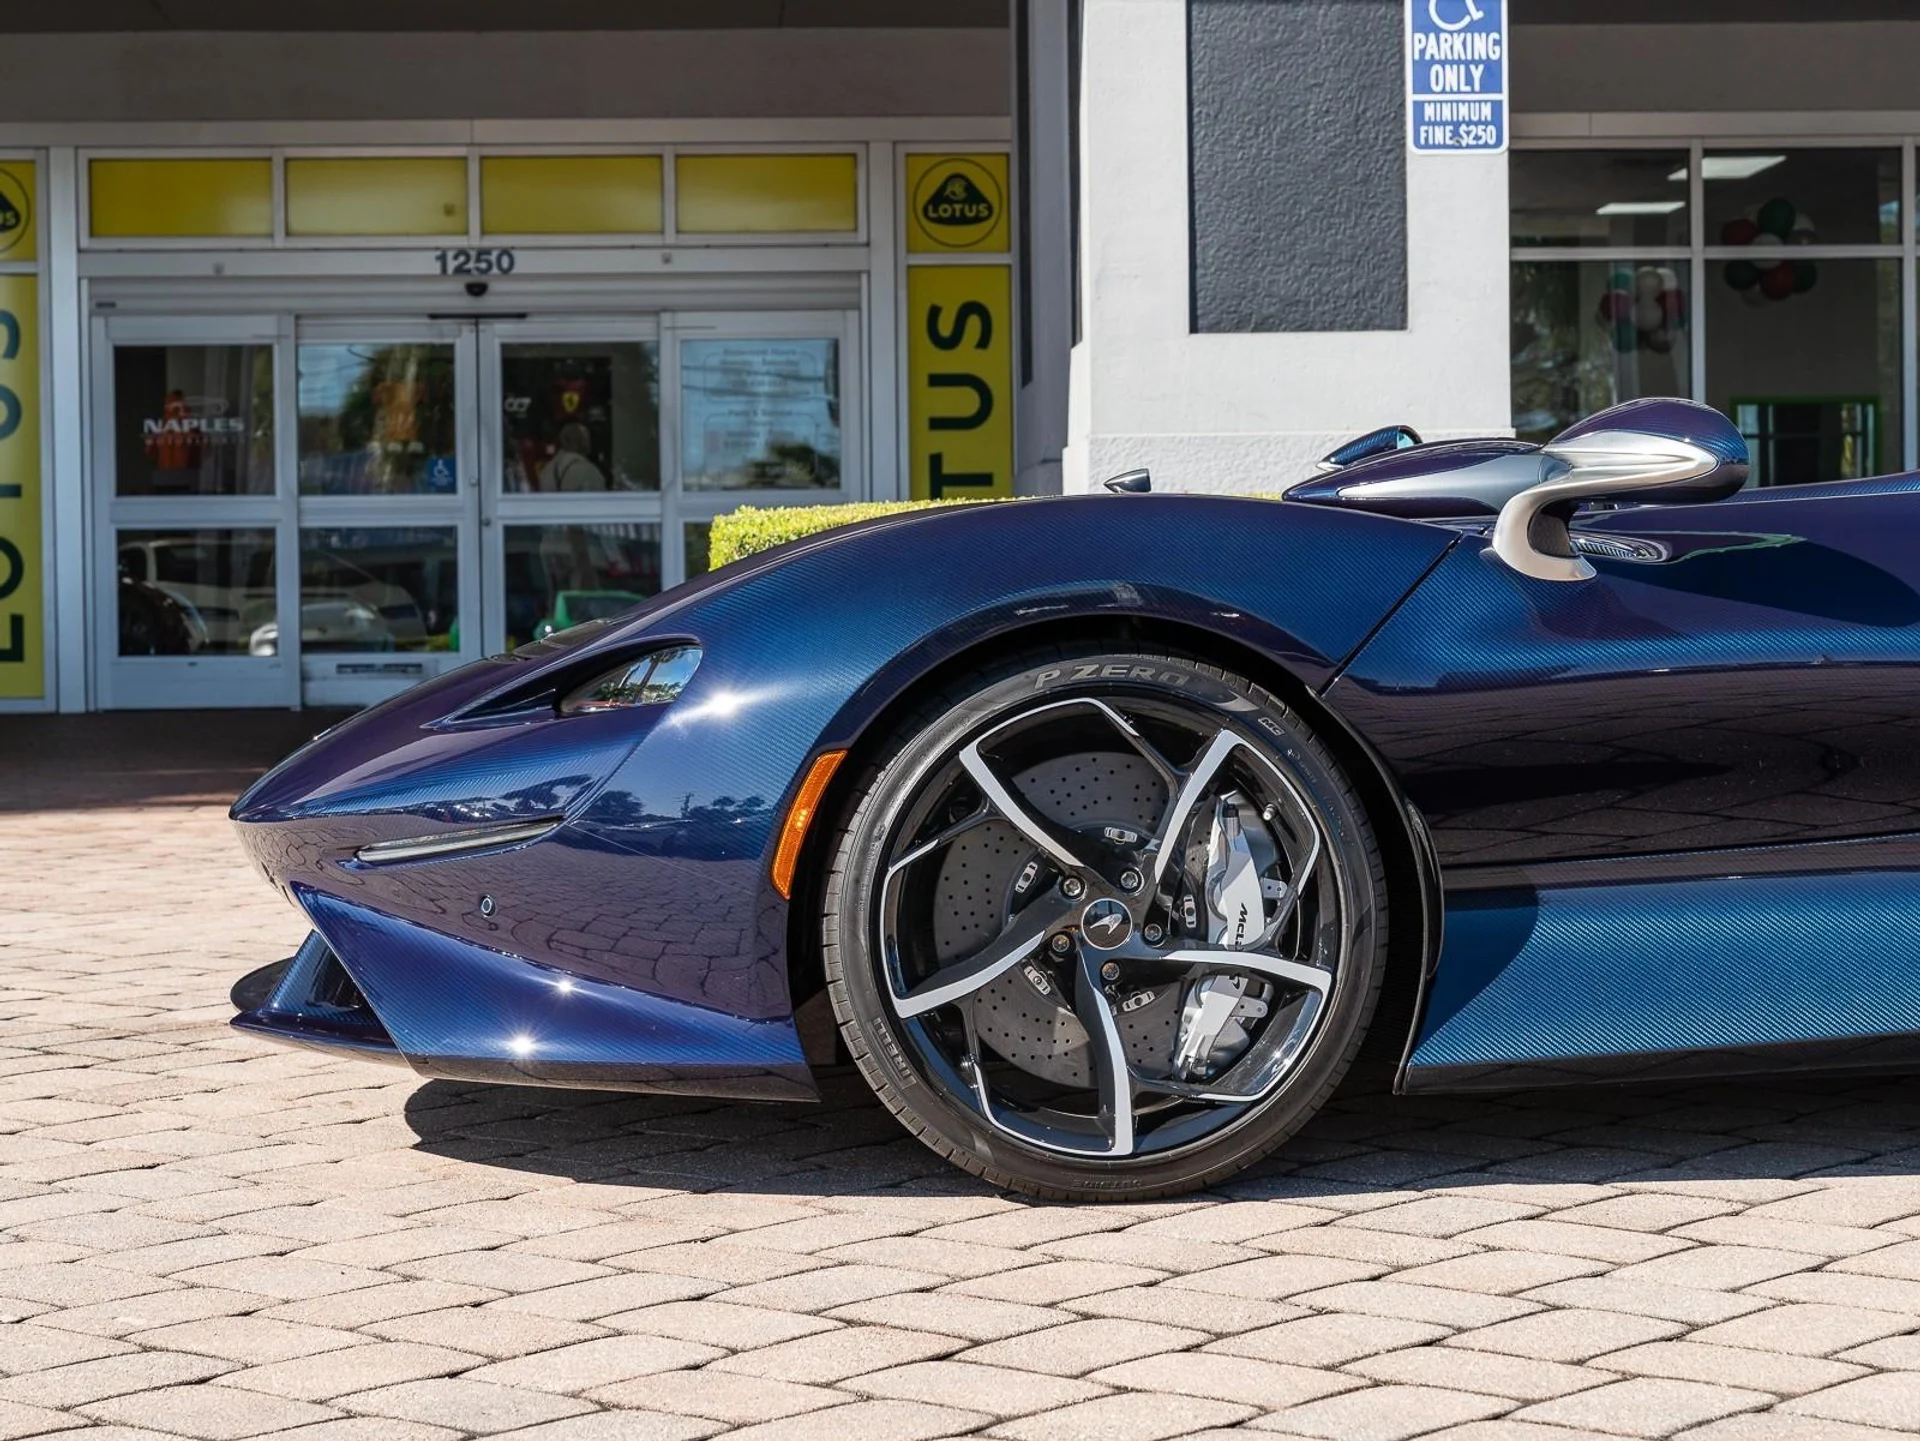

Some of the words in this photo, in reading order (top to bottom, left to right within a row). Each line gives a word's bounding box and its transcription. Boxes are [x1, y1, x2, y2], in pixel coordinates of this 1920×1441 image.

[1413, 32, 1501, 60] PARKING
[1429, 64, 1485, 92] ONLY
[1423, 102, 1492, 122] MINIMUM
[1419, 125, 1454, 145] FINE
[1459, 123, 1497, 147] $250
[927, 203, 990, 218] LOTUS
[434, 249, 515, 275] 1250
[143, 417, 245, 434] NAPLES
[1034, 668, 1062, 690] P
[1070, 664, 1190, 687] ZERO
[867, 1017, 917, 1091] PIRELLI
